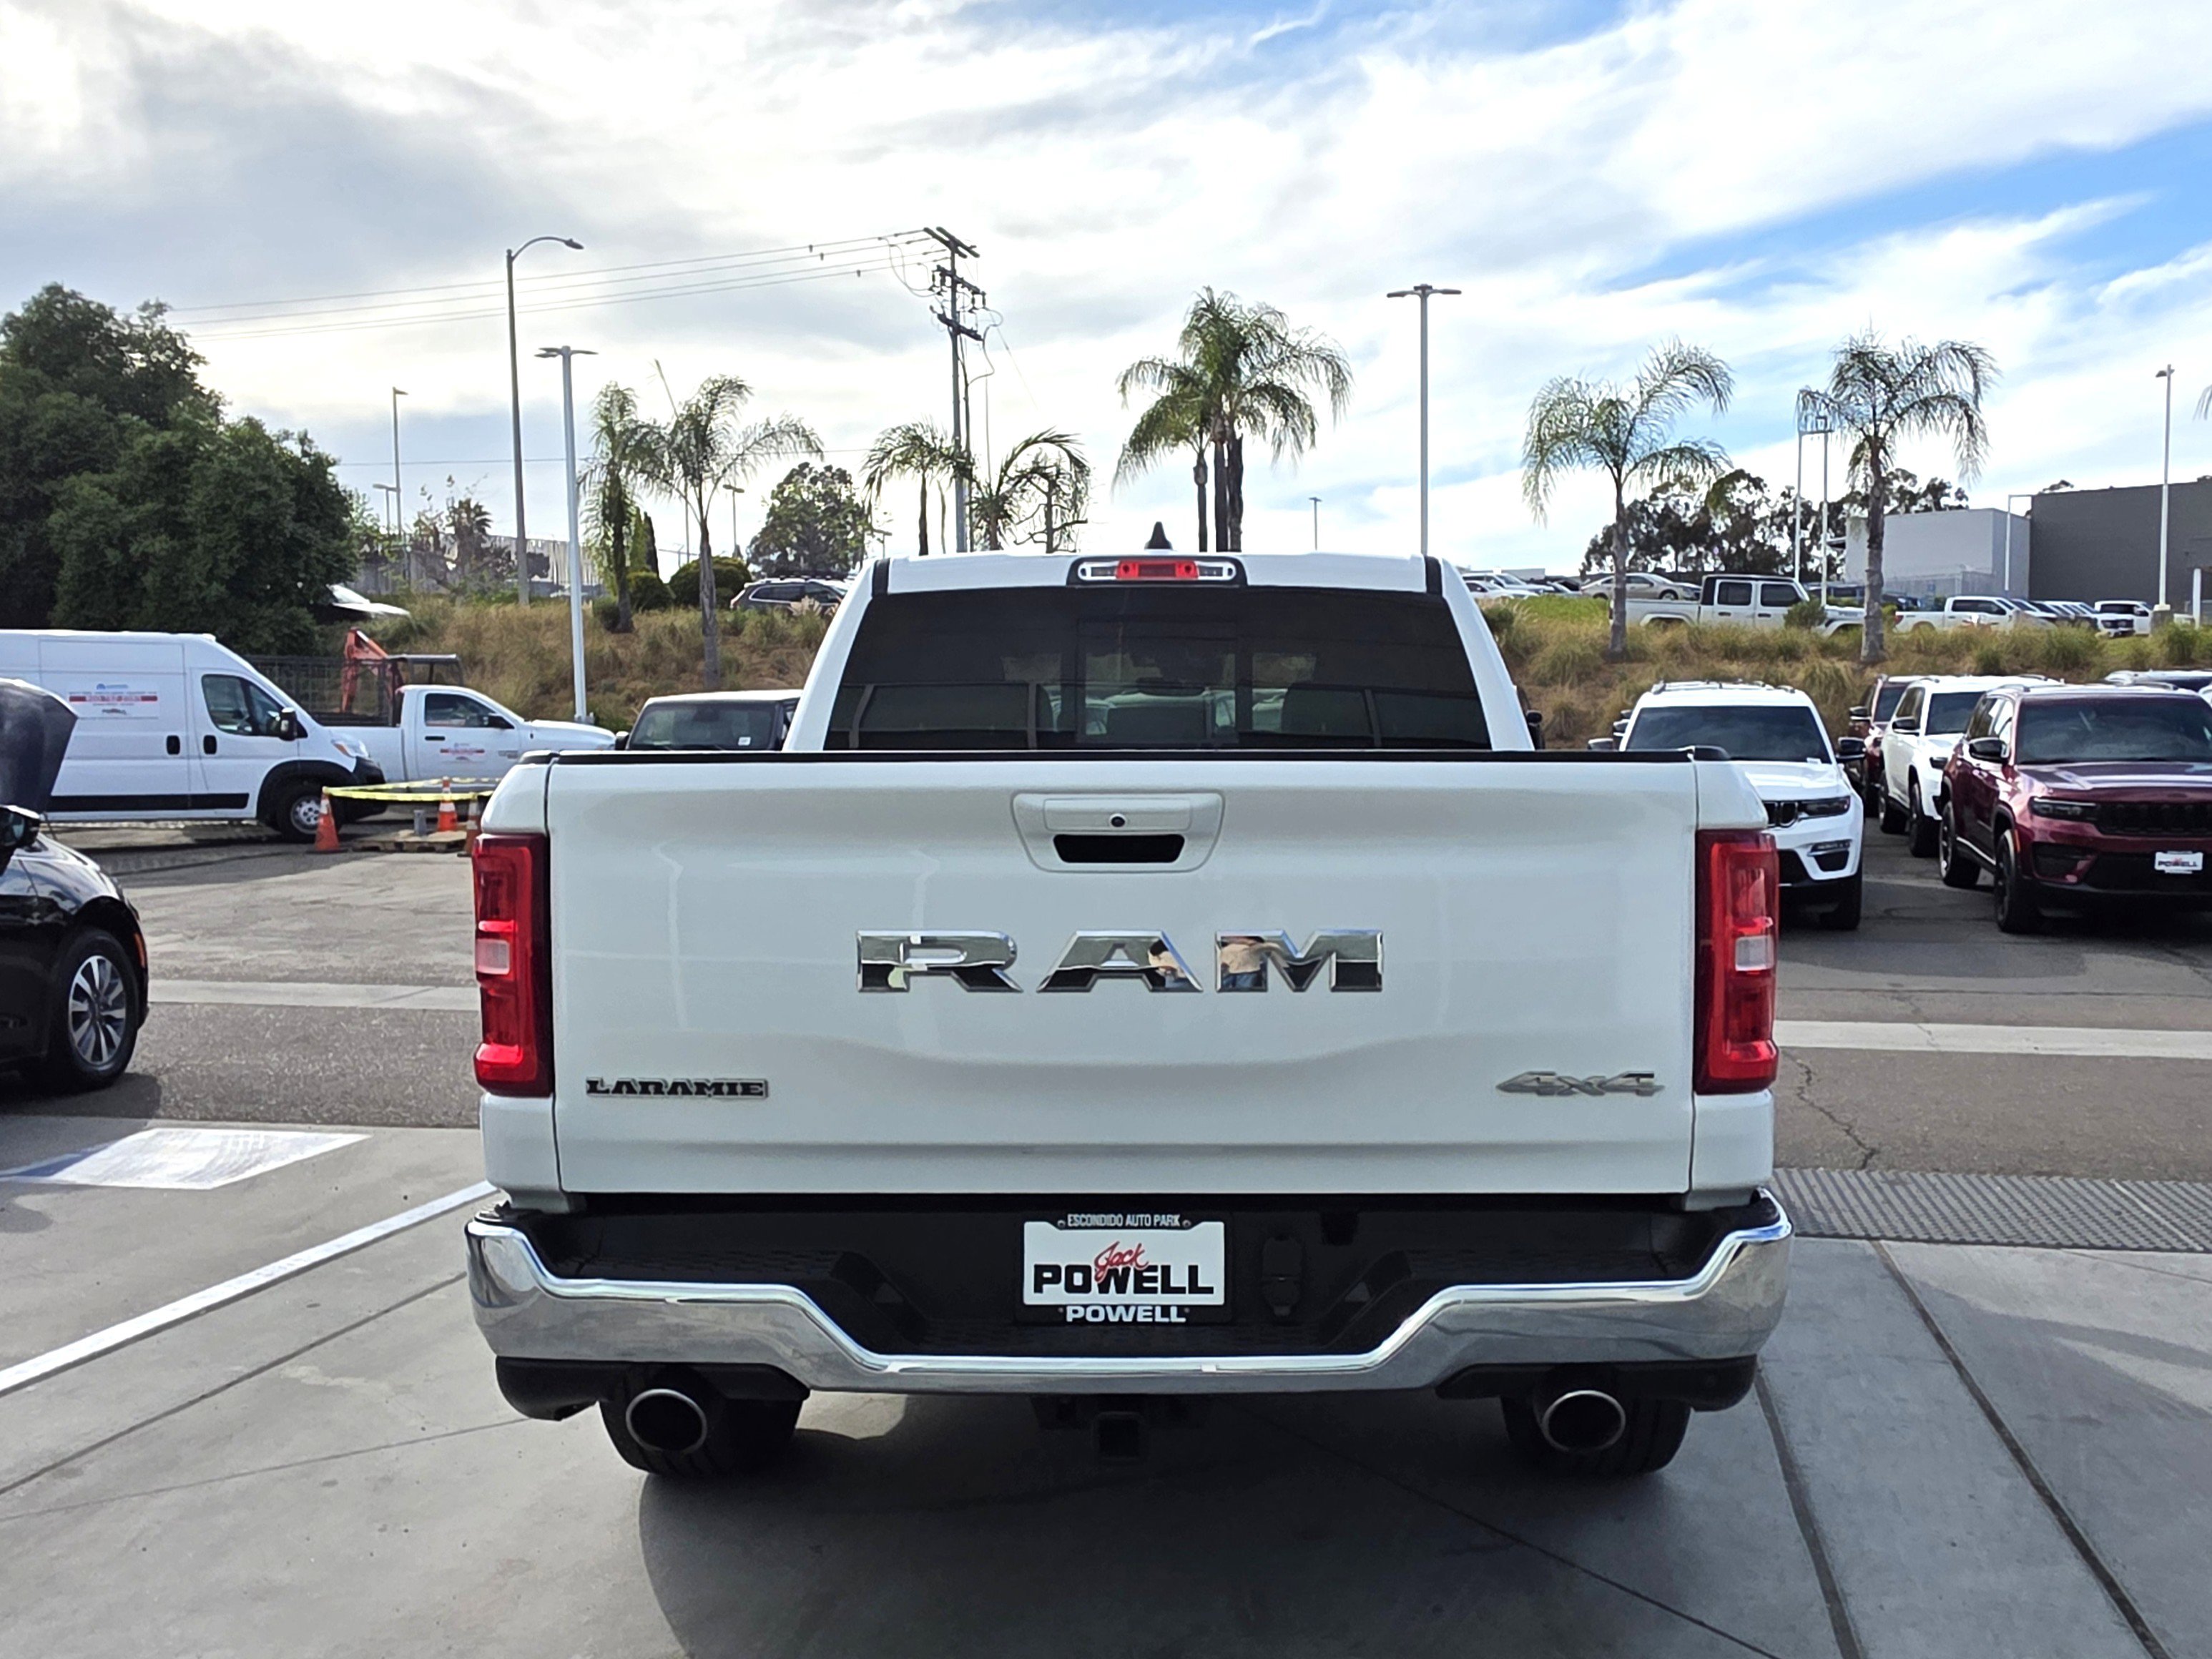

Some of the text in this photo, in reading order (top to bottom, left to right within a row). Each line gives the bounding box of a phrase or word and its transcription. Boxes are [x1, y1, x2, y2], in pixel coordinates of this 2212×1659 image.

[857, 930, 1385, 993] RAM
[586, 1077, 769, 1098] LARAMIE
[1068, 1214, 1180, 1226] ESCONDIDO AUTO PARK
[1094, 1241, 1149, 1284] Jack
[1033, 1264, 1214, 1294] POWELL
[1066, 1306, 1186, 1322] POWELL
